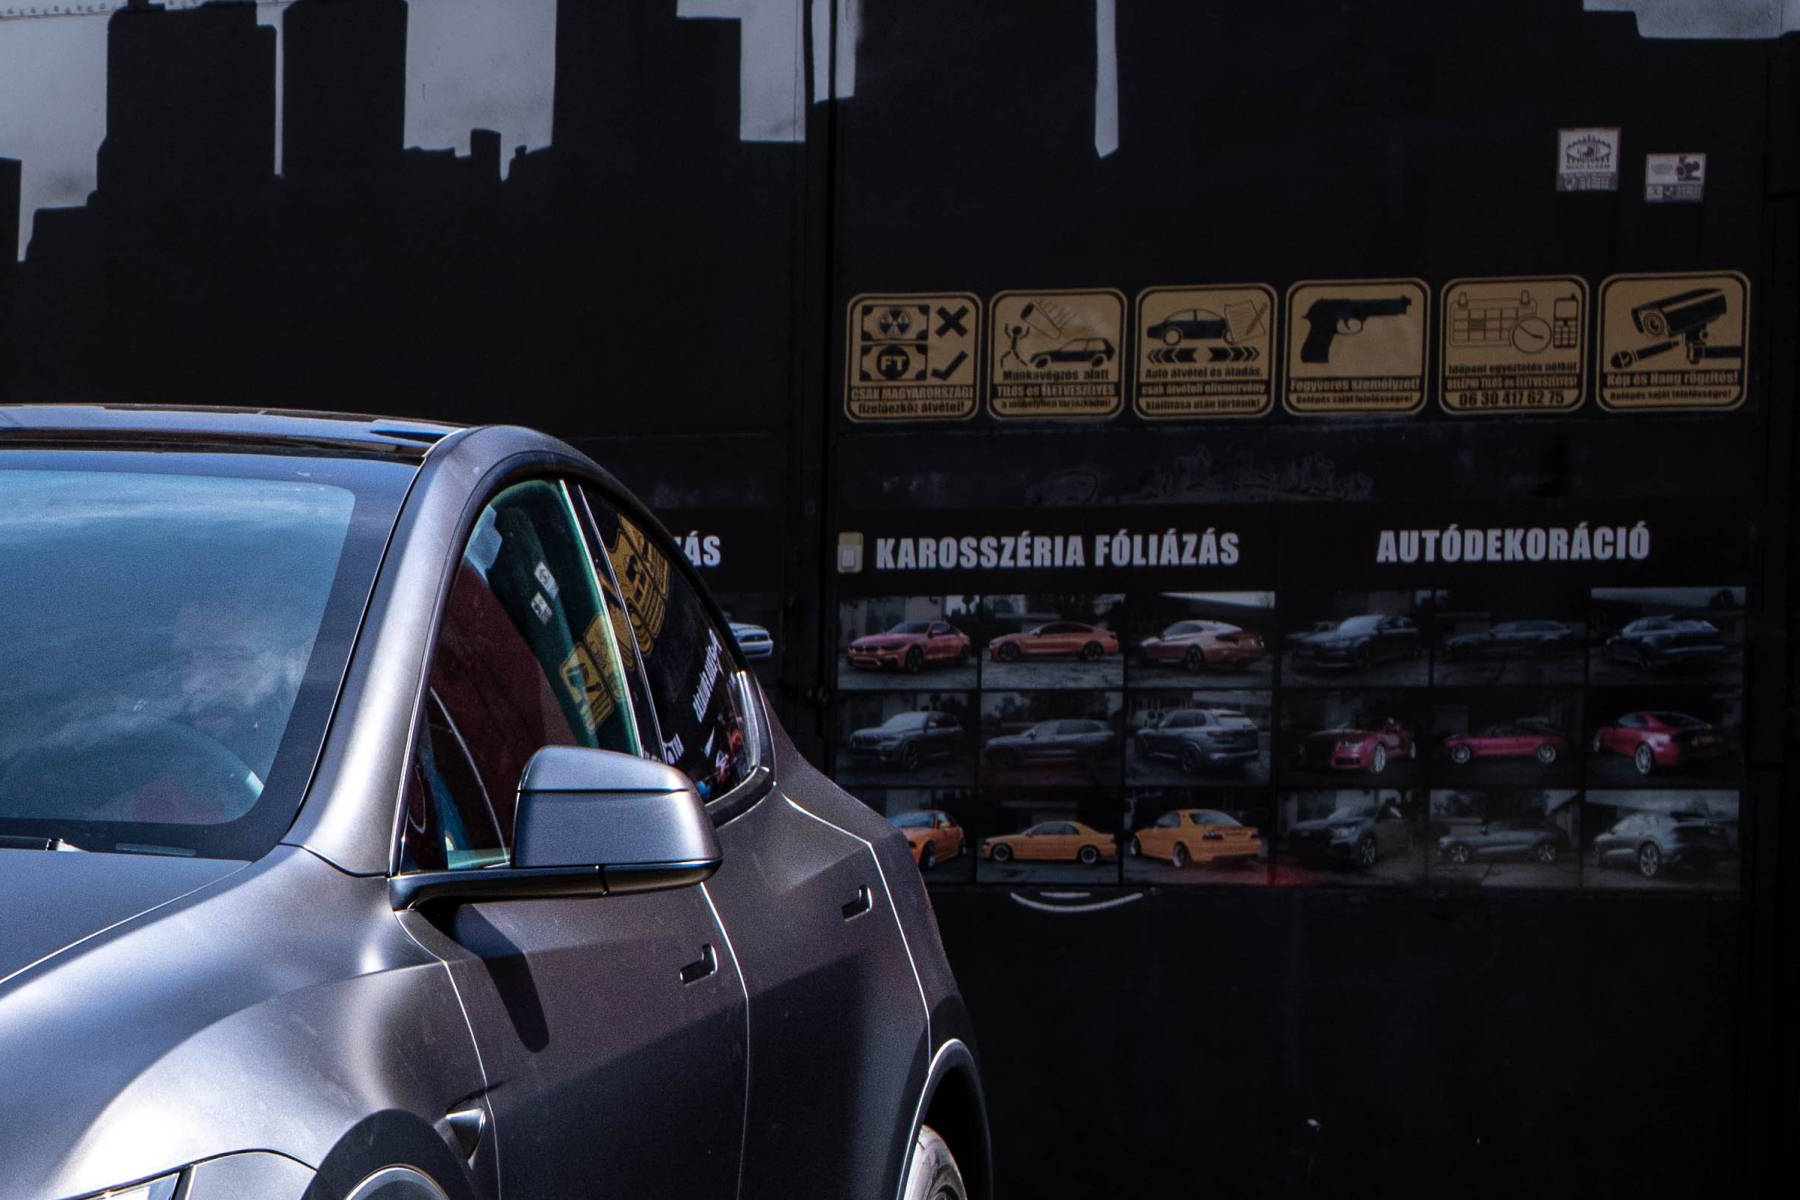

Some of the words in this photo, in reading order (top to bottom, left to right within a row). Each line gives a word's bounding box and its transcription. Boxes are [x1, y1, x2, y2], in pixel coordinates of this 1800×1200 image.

[880, 355, 907, 371] FT
[1290, 380, 1350, 392] Fegyveres
[1606, 374, 1630, 387] Kép
[1633, 374, 1648, 385] és
[1650, 373, 1682, 386] Hang
[1684, 370, 1738, 385] rögzítés!
[851, 388, 880, 400] CSAK
[881, 386, 974, 400] MAGYARORSZÁGI
[1459, 392, 1477, 405] 06
[1481, 391, 1499, 405] 30
[1549, 390, 1564, 404] 75
[675, 530, 721, 567] ÁS
[876, 532, 1084, 571] KAROSSZÉRIA
[1094, 528, 1239, 567] FÓLIÁZÁS
[1376, 522, 1649, 563] AUTÓDEKORÁCIÓ
